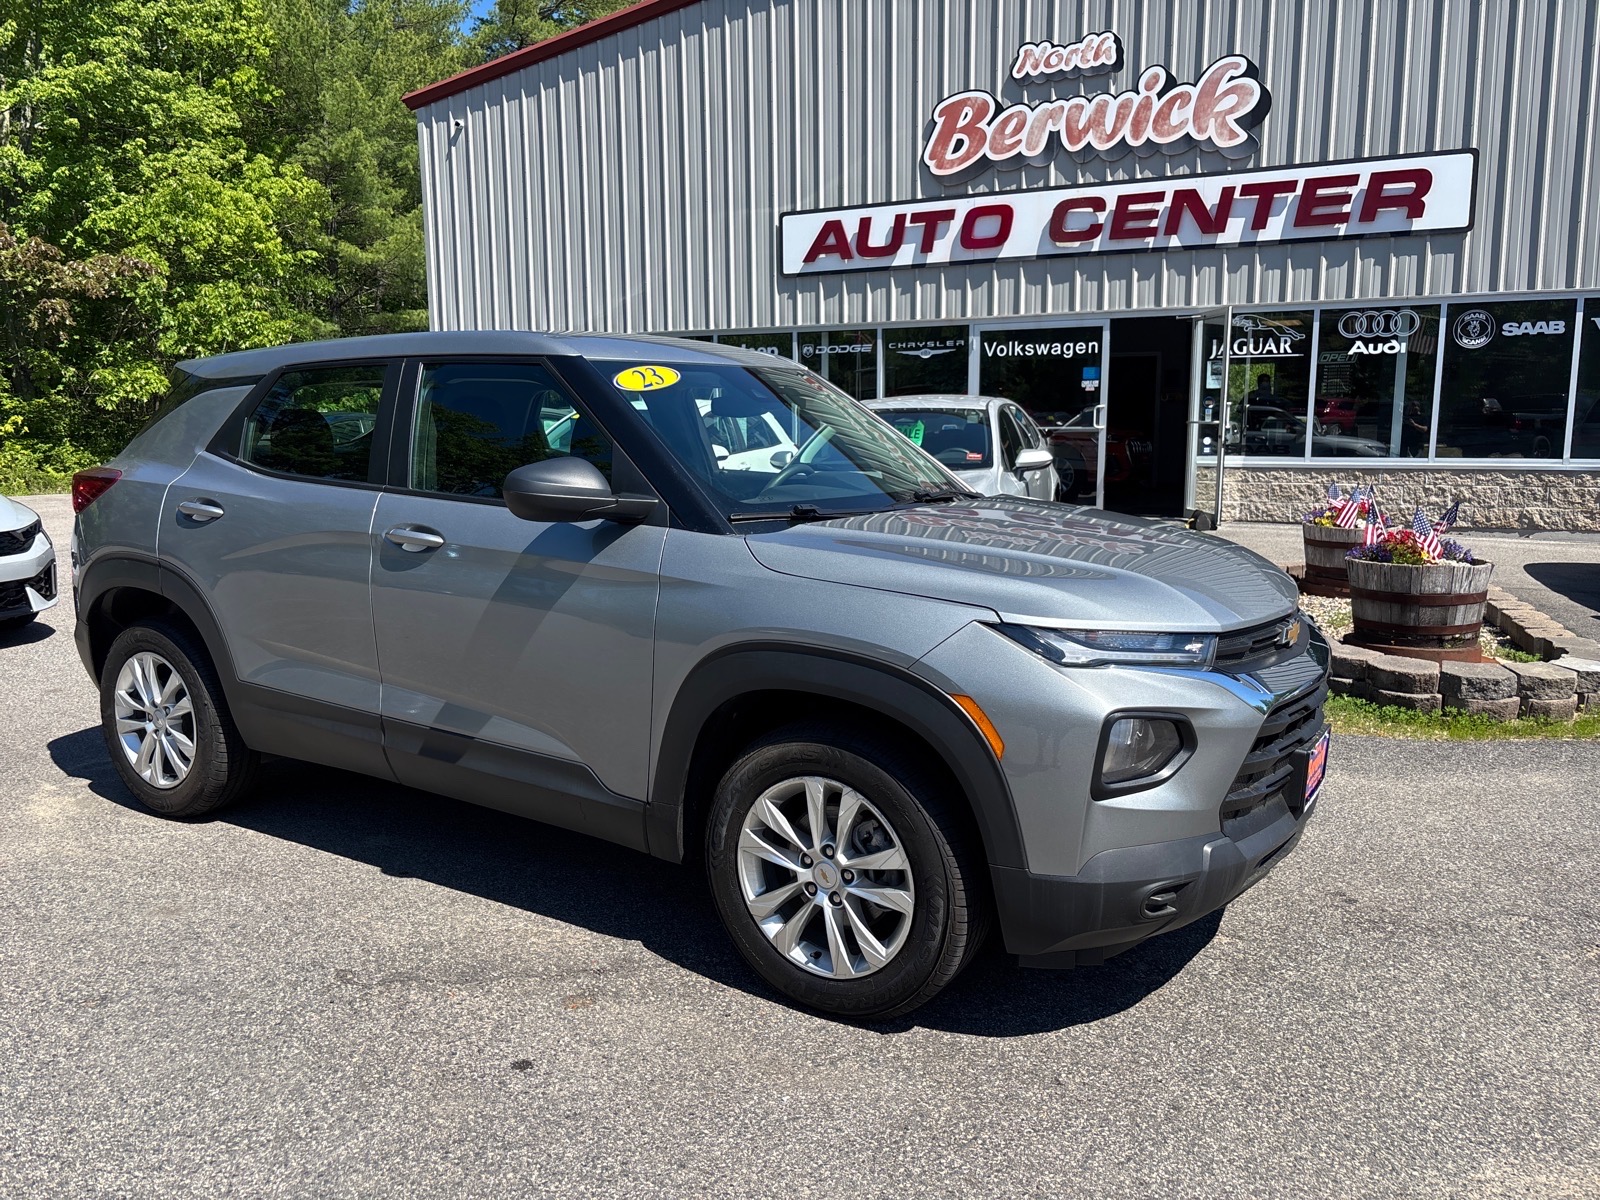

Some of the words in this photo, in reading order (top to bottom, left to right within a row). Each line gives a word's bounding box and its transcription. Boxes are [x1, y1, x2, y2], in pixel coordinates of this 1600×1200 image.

[1016, 33, 1116, 76] North
[927, 57, 1257, 173] Berwick
[803, 203, 1014, 264] AUTO
[1049, 168, 1434, 243] CENTER
[1502, 321, 1565, 336] SAAB
[815, 344, 872, 355] DODGE
[888, 340, 964, 349] CHRYSLER
[984, 341, 1099, 358] Volkswagen
[1209, 337, 1292, 359] JAGUAR
[1347, 339, 1406, 355] Audi
[632, 367, 664, 388] 23
